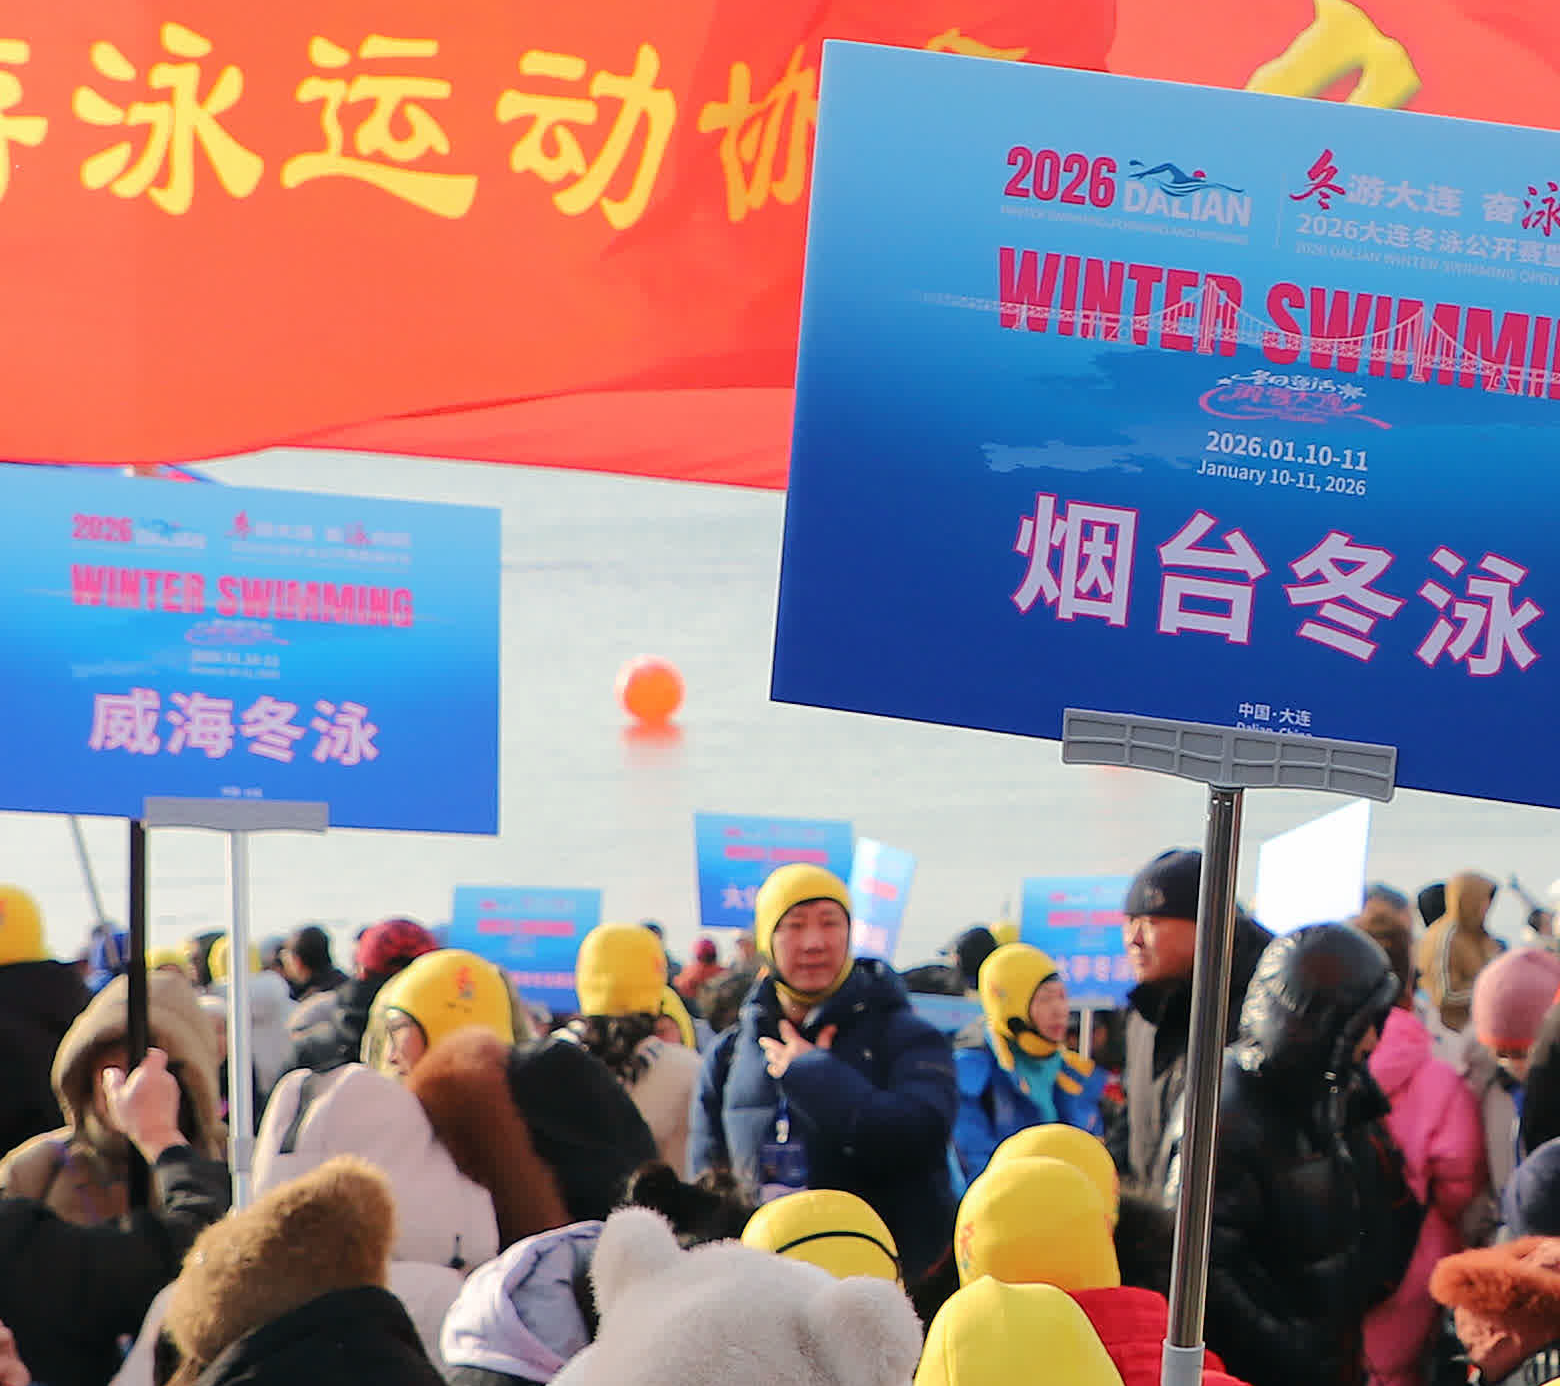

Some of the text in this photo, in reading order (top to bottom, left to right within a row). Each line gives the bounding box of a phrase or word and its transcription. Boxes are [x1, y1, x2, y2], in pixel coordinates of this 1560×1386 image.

[1003, 145, 1118, 209] 2026
[1123, 179, 1252, 227] DALIAN
[1289, 148, 1463, 217] 冬游大连
[998, 246, 1242, 360] WINTER
[1197, 460, 1367, 496] January 10-11, 2026
[1206, 430, 1369, 472] 2026.01.10-11
[70, 563, 414, 629] WINTER SWIMMING
[1010, 491, 1545, 677] 烟台冬泳
[88, 686, 381, 767] 威海冬泳
[1238, 701, 1313, 728] 中国·大连
